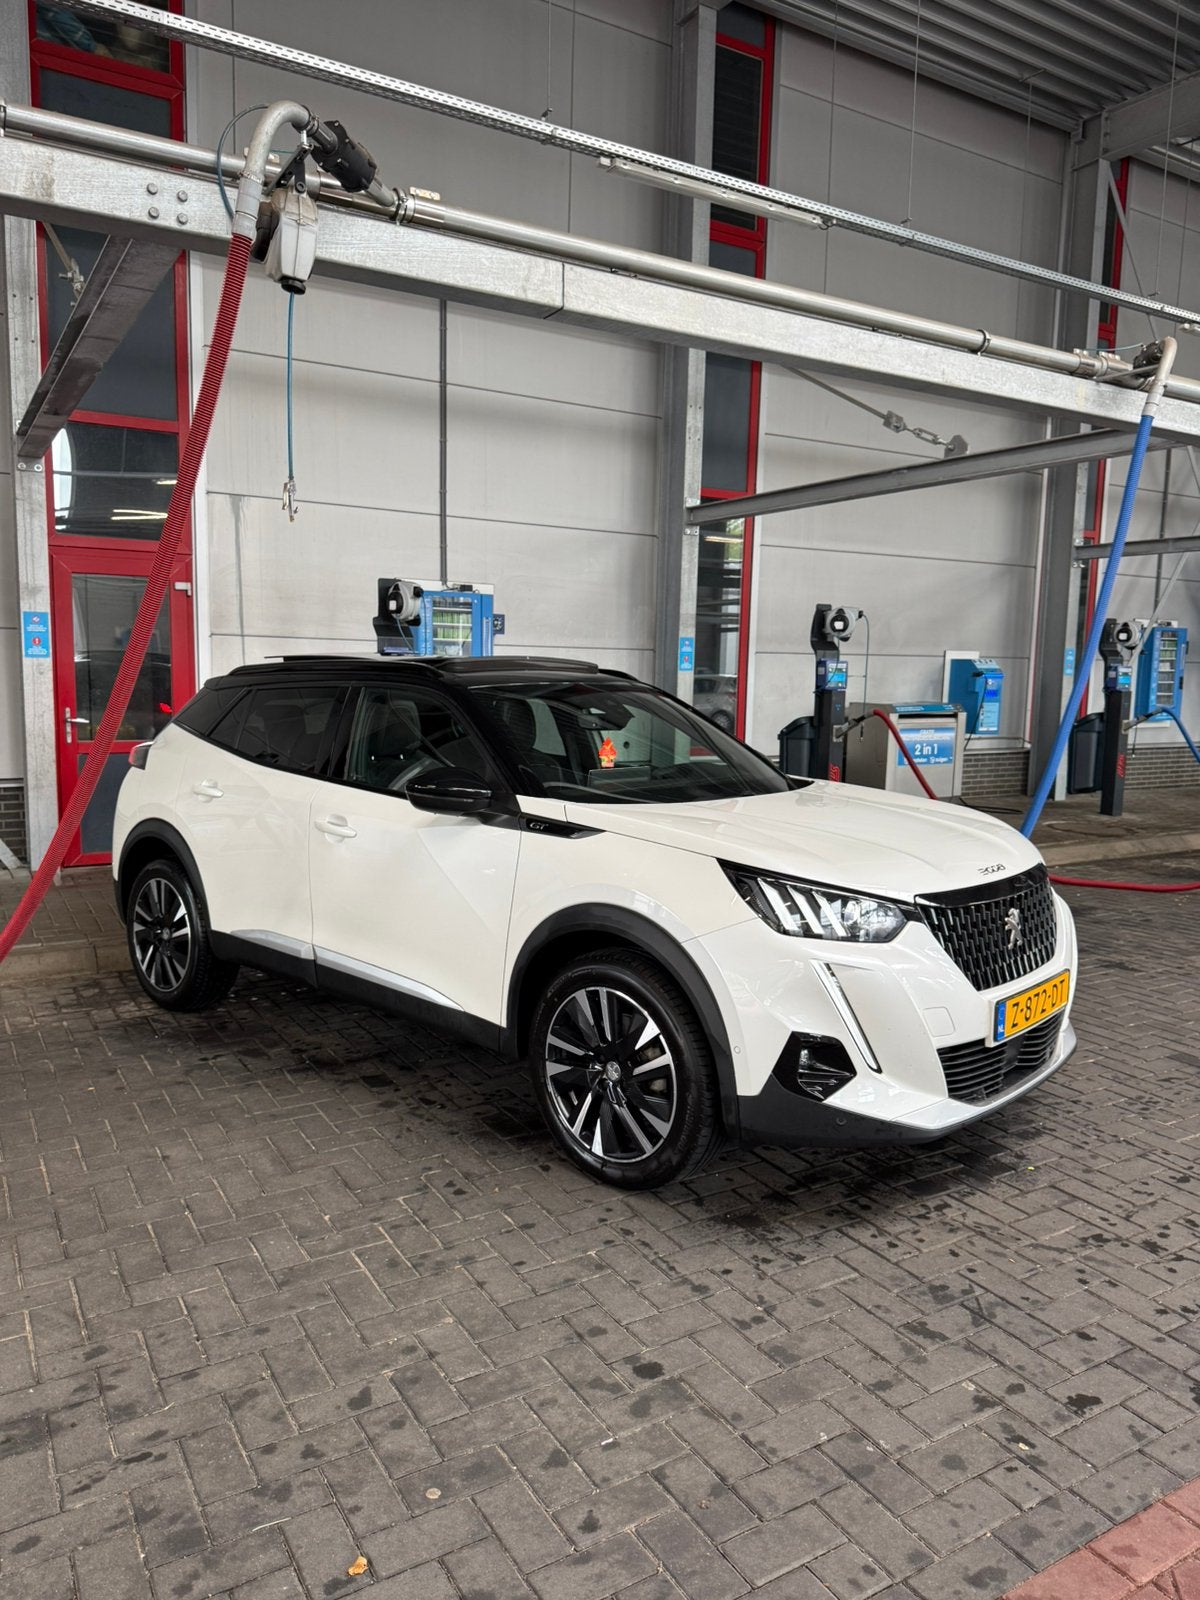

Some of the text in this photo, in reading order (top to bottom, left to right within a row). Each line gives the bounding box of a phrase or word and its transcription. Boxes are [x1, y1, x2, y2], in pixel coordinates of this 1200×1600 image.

[914, 743, 938, 755] 2 in 1
[529, 821, 549, 831] GT
[1010, 978, 1066, 1029] Z-872-DT
